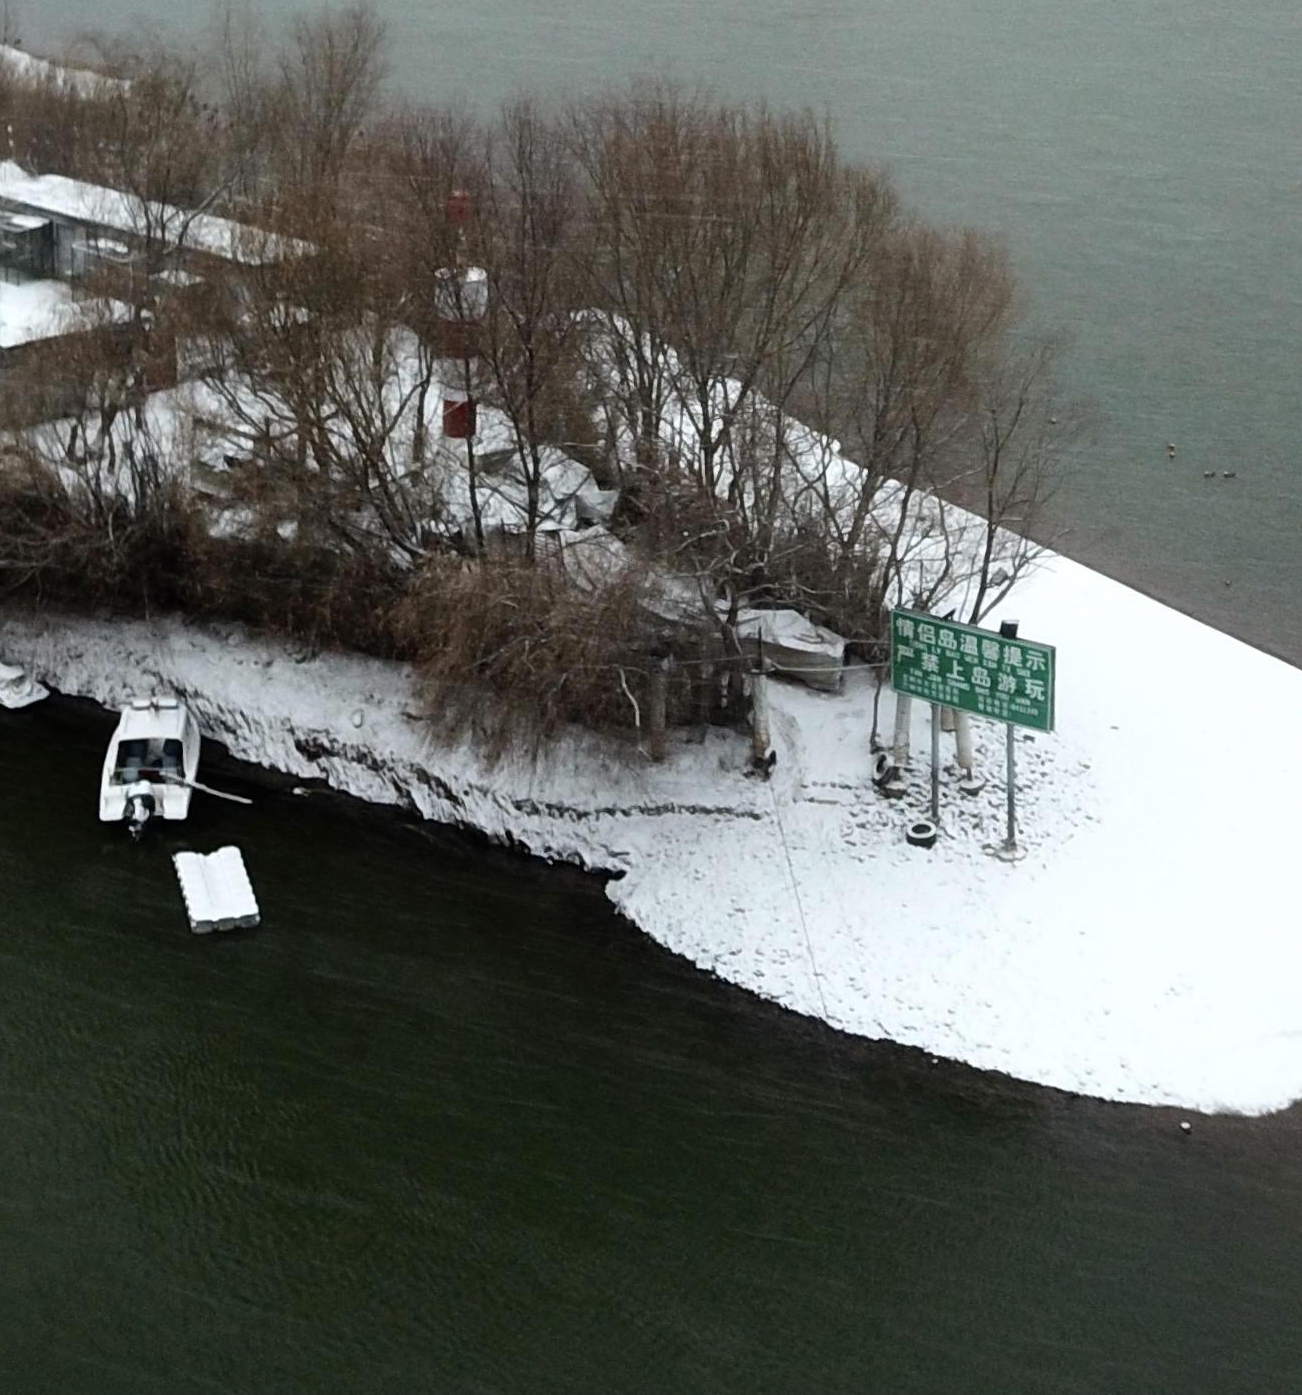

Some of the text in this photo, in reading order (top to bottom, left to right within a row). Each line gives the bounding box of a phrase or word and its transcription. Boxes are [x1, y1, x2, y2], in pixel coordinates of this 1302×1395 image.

[896, 618, 1045, 671] 情侣岛温馨提示
[897, 645, 1045, 701] 严禁上岛游玩
